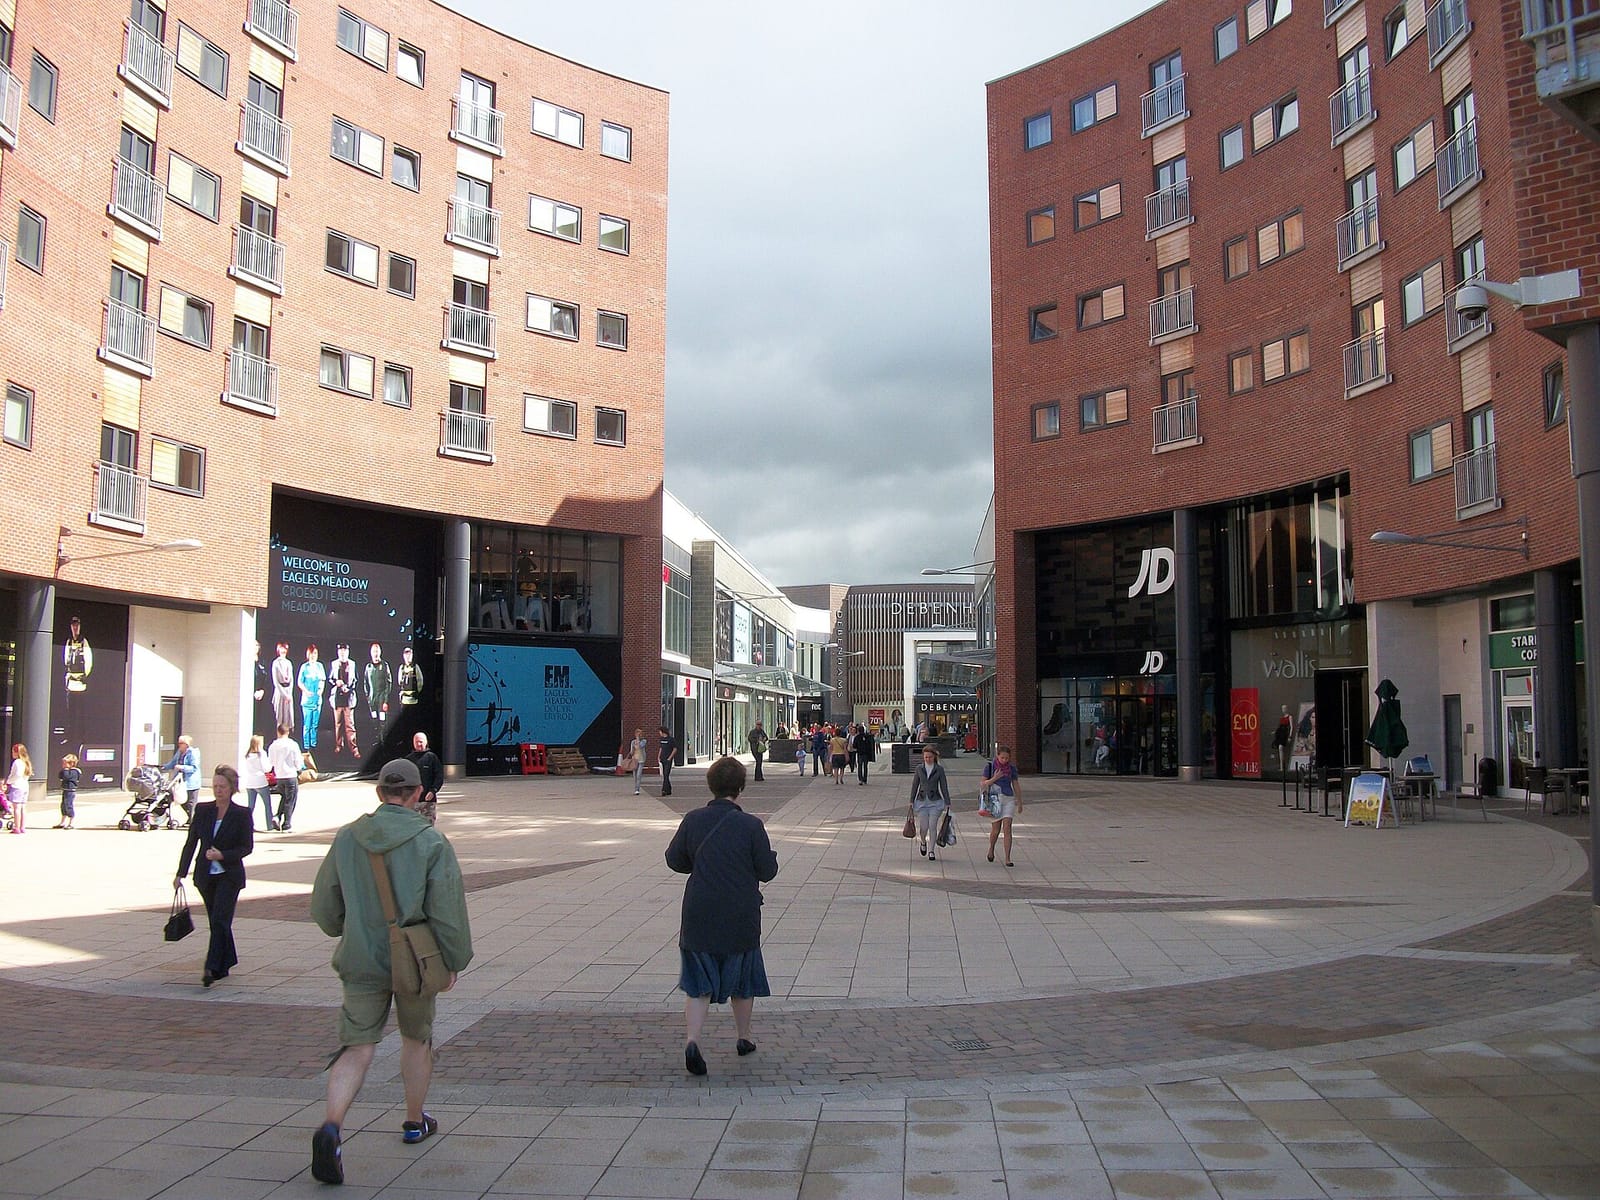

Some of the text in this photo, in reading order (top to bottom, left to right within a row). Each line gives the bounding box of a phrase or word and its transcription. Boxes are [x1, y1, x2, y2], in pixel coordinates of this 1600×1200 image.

[282, 556, 350, 575] WELCOME TO
[1128, 547, 1175, 598] JD
[282, 571, 369, 590] EAGLES MEADOW
[281, 585, 323, 600] CROESO
[331, 591, 369, 604] EAGLES
[281, 601, 328, 615] MEADOW
[891, 602, 972, 615] DEBENH
[836, 610, 844, 698] DEBENHAMS
[1140, 651, 1164, 674] JD
[1233, 713, 1258, 730] £10
[1233, 761, 1259, 773] SALE
